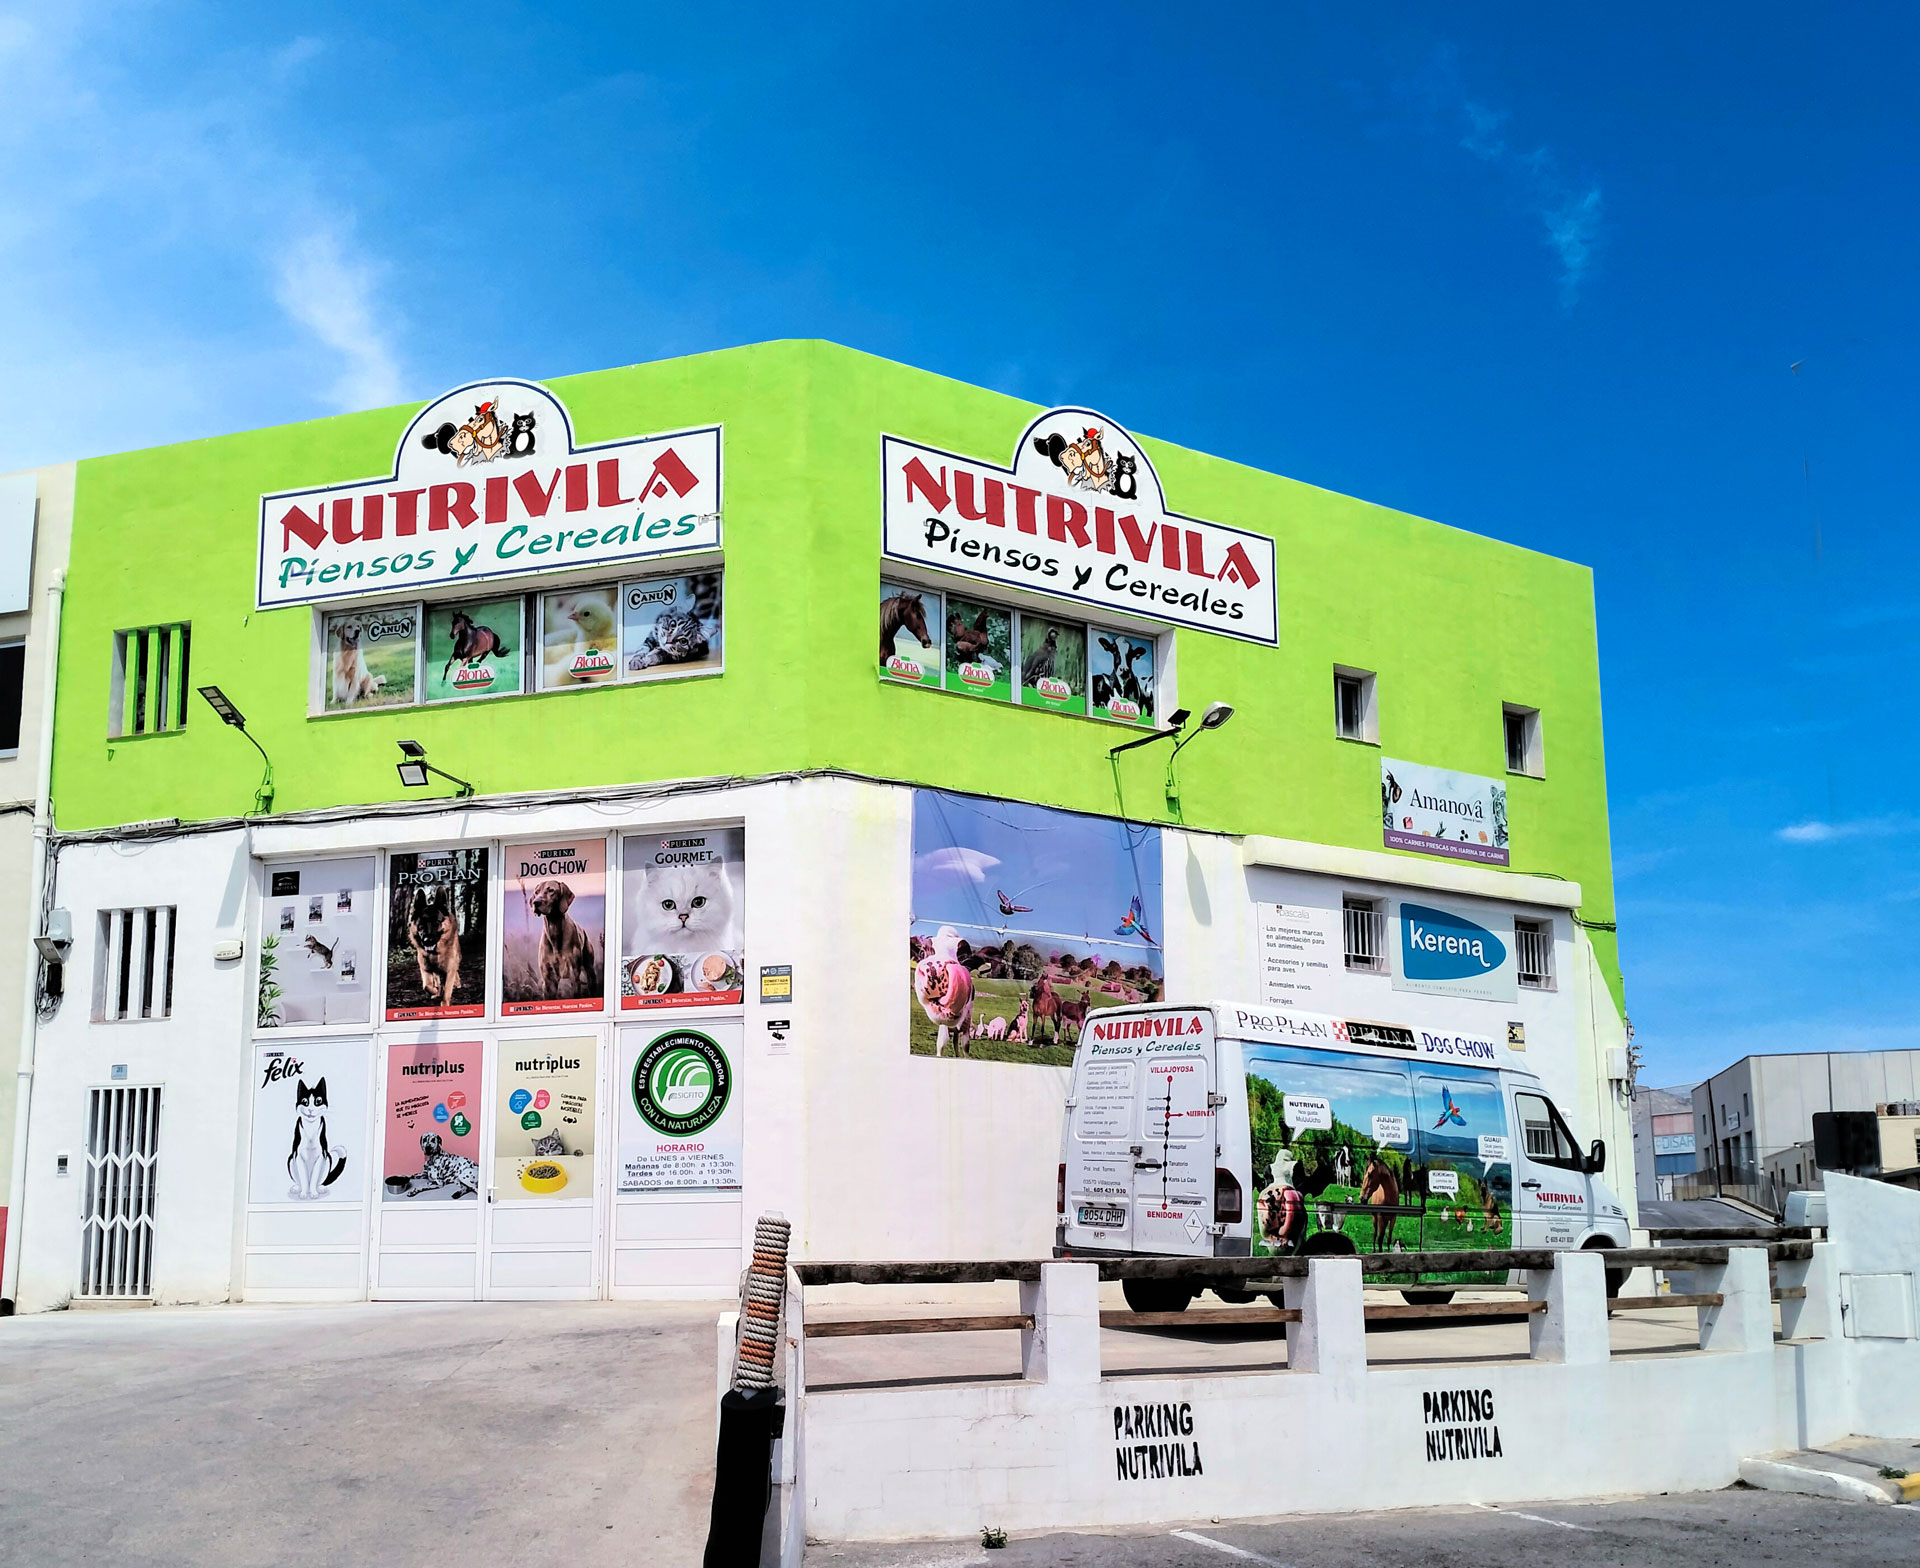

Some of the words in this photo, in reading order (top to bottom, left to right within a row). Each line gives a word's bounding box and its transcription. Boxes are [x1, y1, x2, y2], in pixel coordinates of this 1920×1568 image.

[280, 448, 699, 553] NUTRIVILA
[902, 456, 1260, 589] NUTRIVILA
[279, 547, 436, 589] Piensos
[449, 543, 478, 575] y
[495, 512, 698, 560] Cereales
[924, 518, 1059, 577] Piensos
[1072, 565, 1093, 591] y
[1105, 563, 1244, 620] Cereales
[669, 838, 705, 848] PURINA
[1404, 838, 1425, 848] CARNES
[1426, 842, 1449, 851] FRESCAS
[1479, 849, 1486, 857] DE
[1487, 850, 1504, 860] CARNE
[426, 858, 459, 867] PURINA
[541, 848, 575, 858] PURINA
[655, 850, 713, 865] GOURMET
[398, 872, 433, 884] PRO
[437, 869, 481, 882] PLAN
[520, 862, 548, 877] DOG
[549, 859, 588, 875] CHOW
[1278, 926, 1301, 936] mejores
[1267, 957, 1300, 966] Accesorios
[1301, 960, 1305, 968] y
[1268, 981, 1295, 990] Animales
[1093, 1016, 1204, 1040] NUTRIVILA
[1236, 1010, 1274, 1032] PRO
[1274, 1015, 1328, 1038] PLAN
[1348, 1025, 1412, 1045] PURINA
[1421, 1032, 1454, 1055] DOG
[1455, 1037, 1495, 1060] CHOW
[643, 1038, 705, 1068] ESTABLECIMIENTO
[1091, 1044, 1133, 1055] Piensos
[1135, 1047, 1143, 1057] y
[1145, 1041, 1202, 1052] Cereales
[261, 1057, 304, 1089] felix
[402, 1058, 465, 1078] nutriplus
[515, 1054, 580, 1073] nutriplus
[704, 1045, 725, 1086] COLABORA
[1150, 1065, 1194, 1074] VILLAJOYOSA
[639, 1068, 648, 1089] ESTE
[640, 1097, 657, 1118] CON
[654, 1114, 667, 1127] LA
[667, 1095, 723, 1130] NATURALEZA
[1289, 1101, 1325, 1109] NUTRIVILA
[656, 1143, 705, 1152] HORARIO
[1536, 1192, 1584, 1204] NUTRIVILA
[1084, 1209, 1105, 1222] 8054
[1105, 1210, 1124, 1222] DHH
[1147, 1211, 1183, 1219] BENIDORM
[1423, 1389, 1494, 1424] PARKING
[1113, 1402, 1194, 1440] PARKING
[1426, 1425, 1503, 1462] NUTRIVILA
[1116, 1441, 1203, 1481] NUTRIVILA
